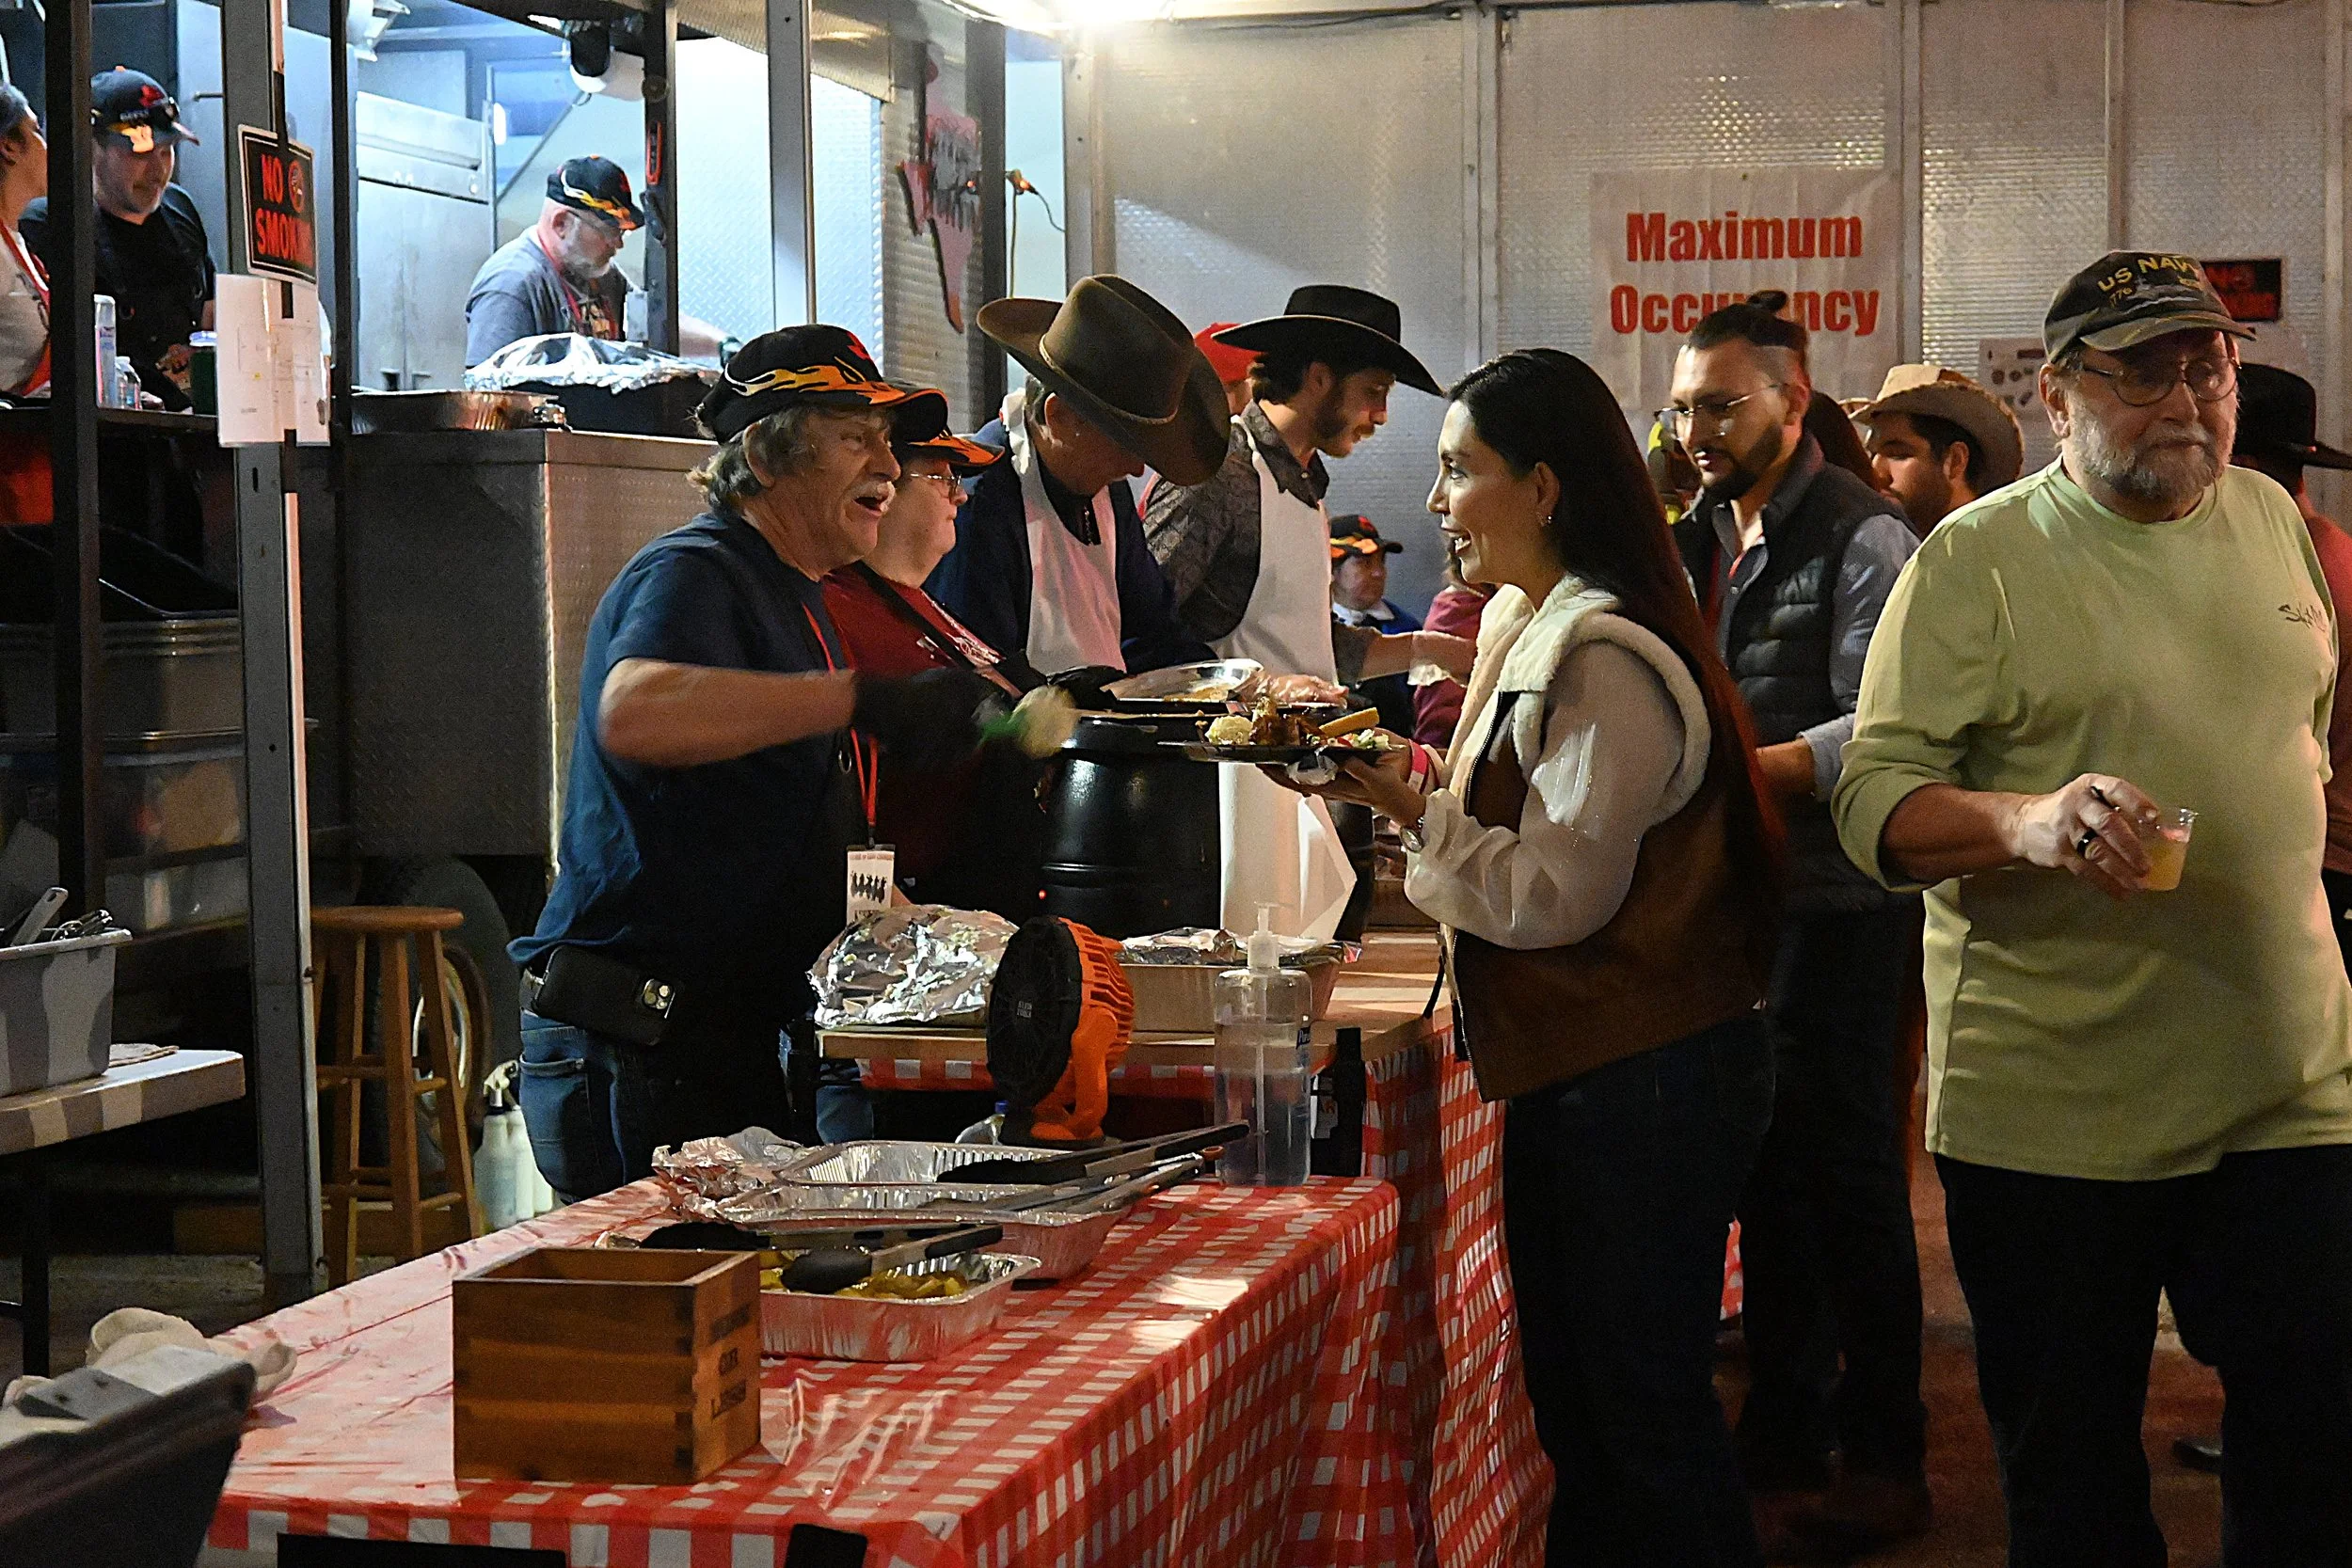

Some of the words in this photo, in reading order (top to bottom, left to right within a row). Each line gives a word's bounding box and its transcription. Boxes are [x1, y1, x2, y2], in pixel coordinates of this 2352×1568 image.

[262, 153, 283, 204] NO
[1626, 211, 1863, 262] Maximum
[2097, 267, 2134, 292] US
